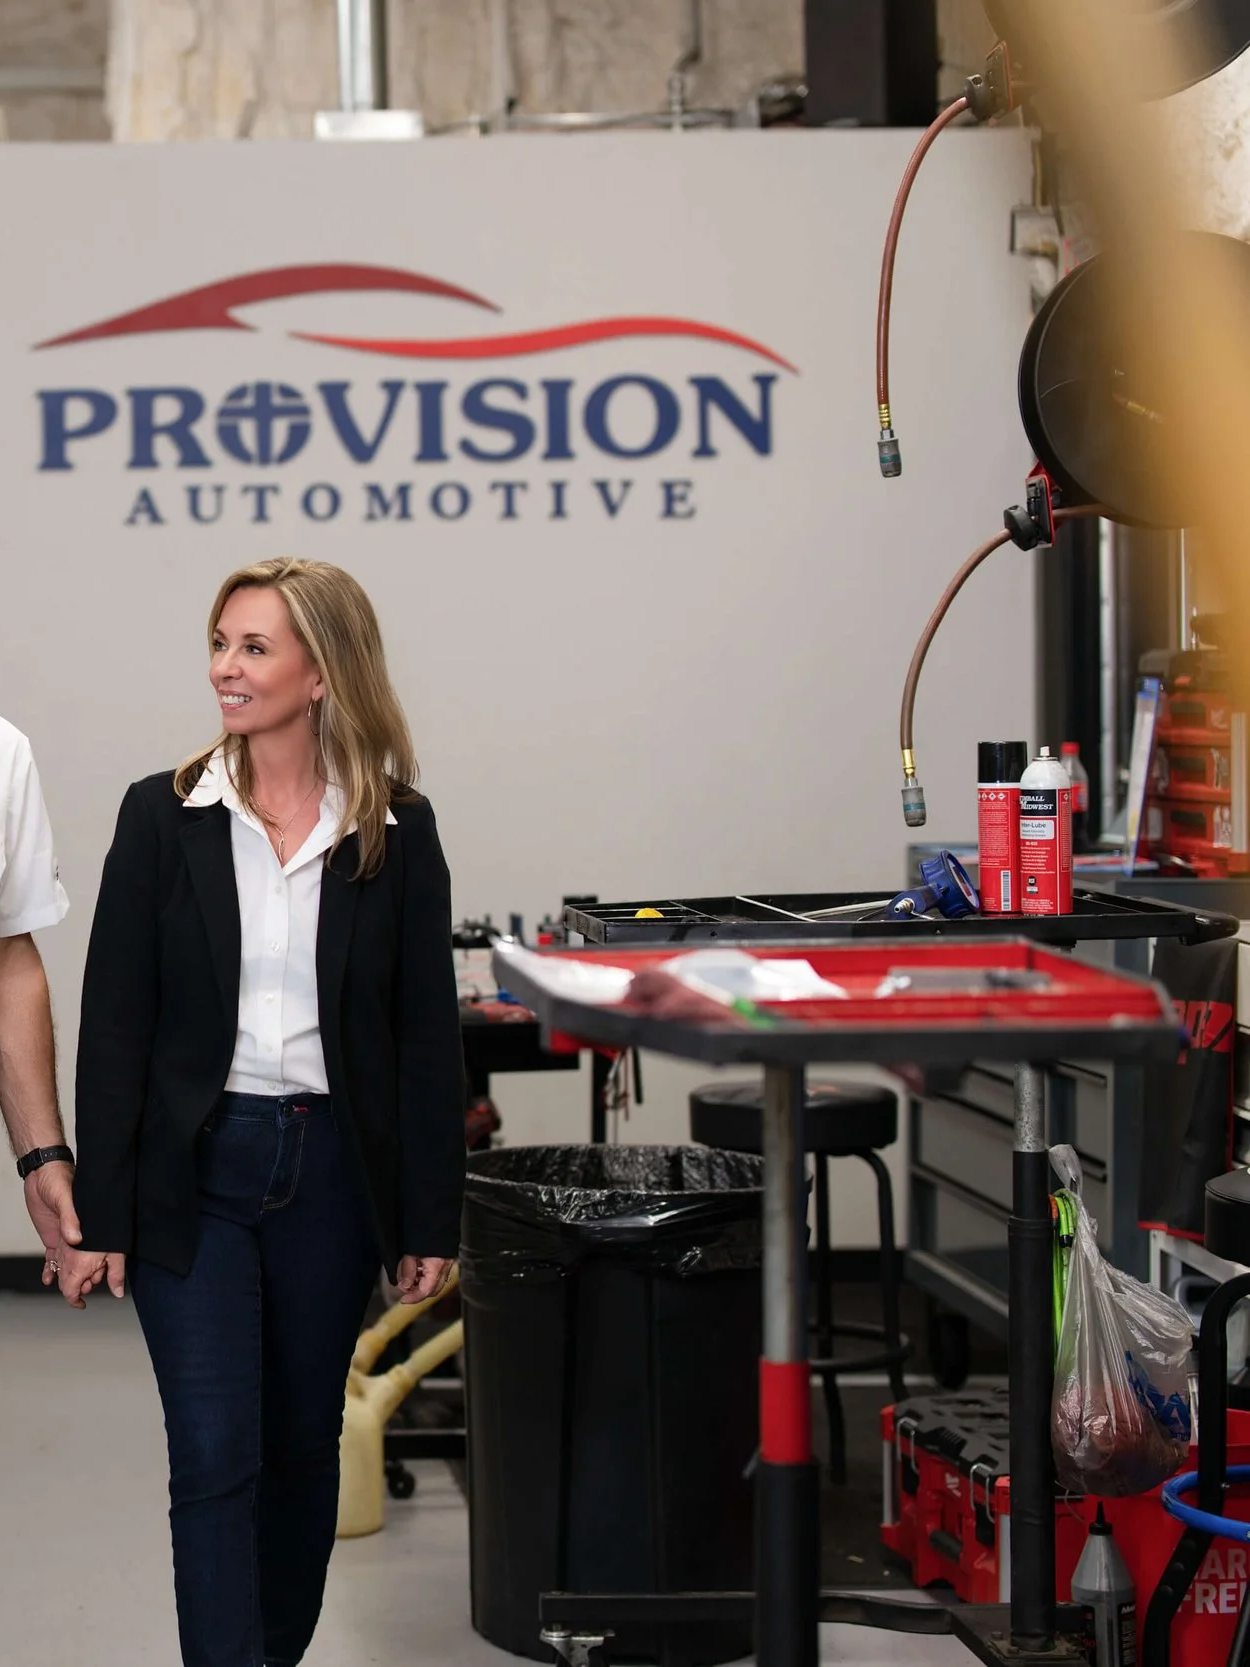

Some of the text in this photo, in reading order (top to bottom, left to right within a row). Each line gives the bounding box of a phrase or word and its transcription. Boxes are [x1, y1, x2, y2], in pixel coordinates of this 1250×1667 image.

[35, 374, 779, 472] PROVISION
[123, 479, 697, 526] AUTOMOTIVE
[1020, 800, 1054, 810] MIDWEST
